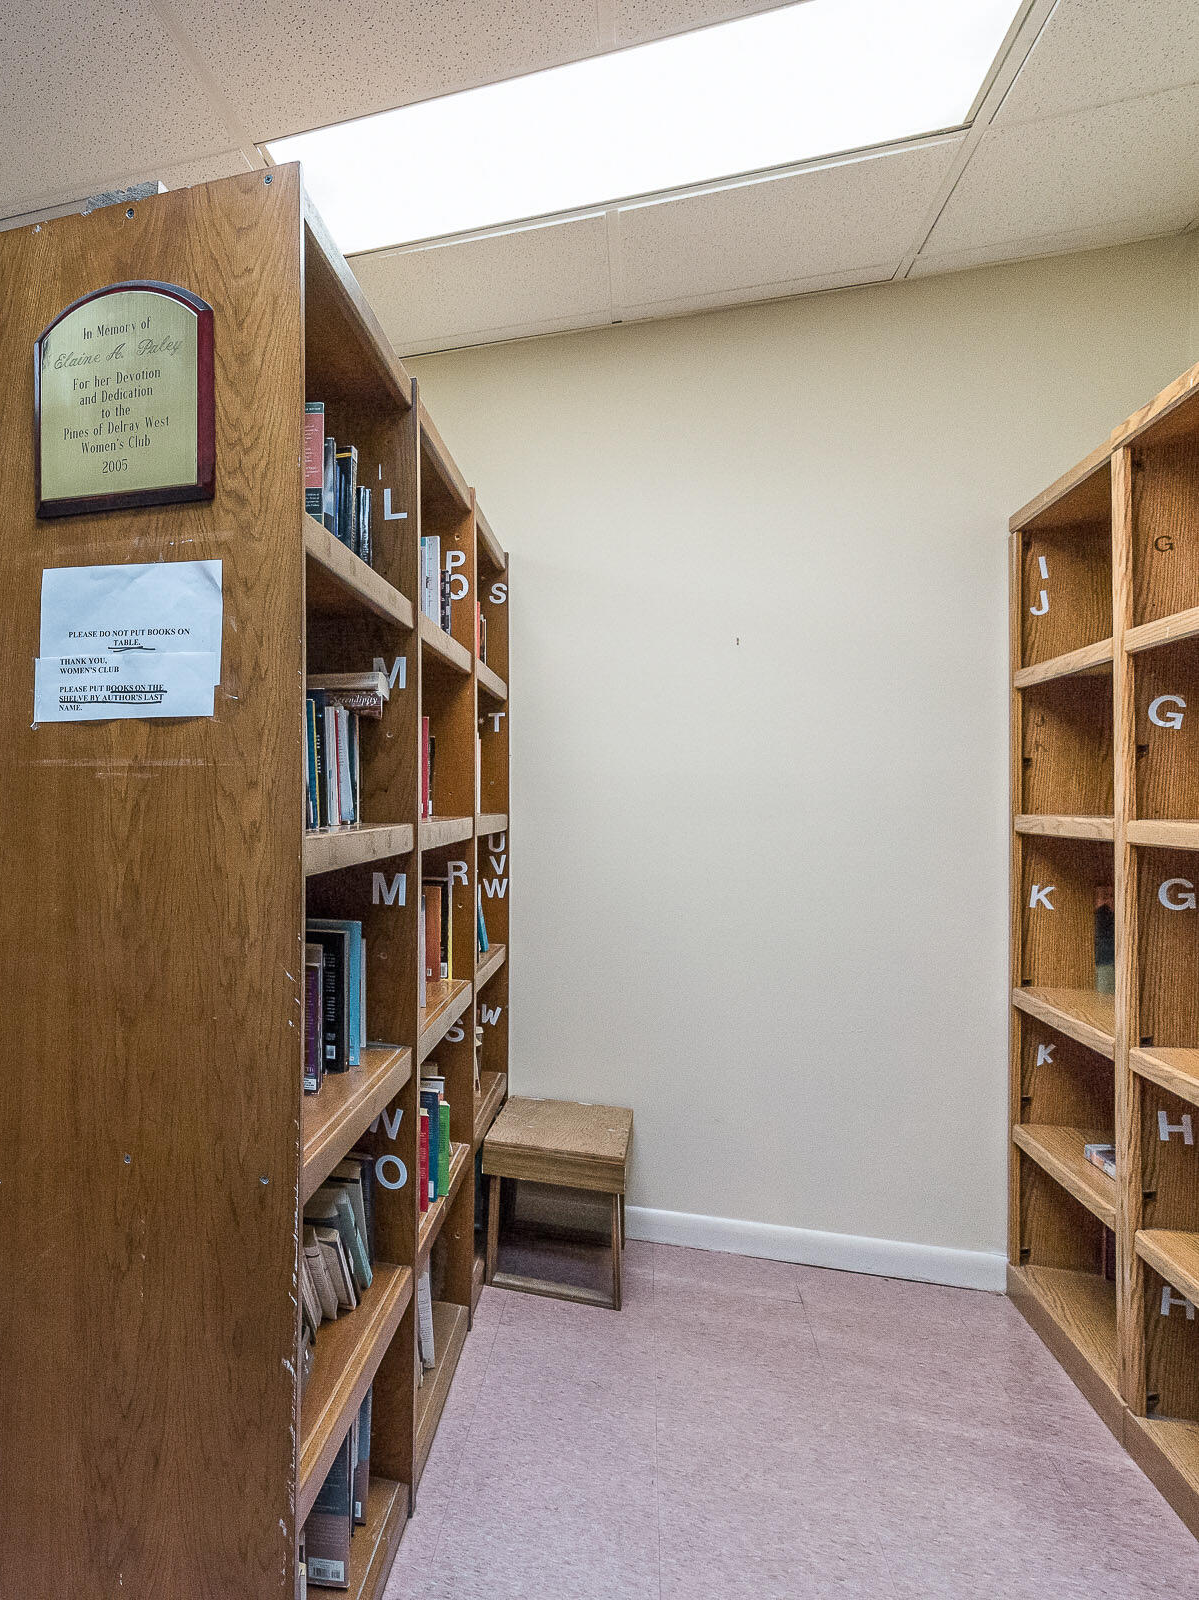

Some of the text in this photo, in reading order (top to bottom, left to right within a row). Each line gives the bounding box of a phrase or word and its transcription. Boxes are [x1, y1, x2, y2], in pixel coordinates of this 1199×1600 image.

[83, 316, 151, 340] In Memory of
[54, 350, 101, 370] Elaine
[137, 335, 183, 356] Paley
[73, 368, 161, 391] For her Devotion
[79, 386, 153, 406] and Dedication
[102, 404, 130, 419] to the
[64, 416, 170, 441] Pines of Delray West
[81, 434, 151, 455] Women's Club
[102, 458, 128, 474] 2005
[384, 488, 408, 521] L
[1154, 536, 1174, 552] G
[446, 551, 466, 577] P
[1038, 556, 1048, 579] I
[489, 583, 508, 606] S
[1029, 590, 1049, 616] J
[68, 631, 98, 639] PLEASE
[99, 630, 111, 638] DO
[130, 629, 146, 637] PUT
[147, 628, 176, 637] BOOKS
[177, 628, 190, 636] ON
[113, 639, 141, 647] TABLE.
[60, 658, 86, 666] THANK
[60, 666, 120, 675] WOMEN'S CLUB
[372, 656, 407, 689] M
[59, 695, 89, 703] SHELVE
[102, 694, 143, 702] AUTHOR'S
[144, 693, 165, 701] LAST
[89, 685, 105, 693] PUT
[134, 684, 147, 692] ON
[331, 694, 378, 706] Serendipity
[59, 704, 83, 712] NAME.
[1147, 695, 1187, 730] G
[489, 712, 505, 732] T
[488, 834, 506, 853] U
[447, 860, 469, 886] R
[489, 854, 506, 875] V
[372, 872, 407, 906] M
[483, 878, 508, 899] W
[1028, 884, 1055, 911] K
[1158, 878, 1196, 911] G
[482, 1004, 502, 1025] W
[1036, 1044, 1056, 1067] K
[1157, 1110, 1194, 1146] H
[376, 1154, 407, 1190] O
[1160, 1286, 1196, 1321] H
